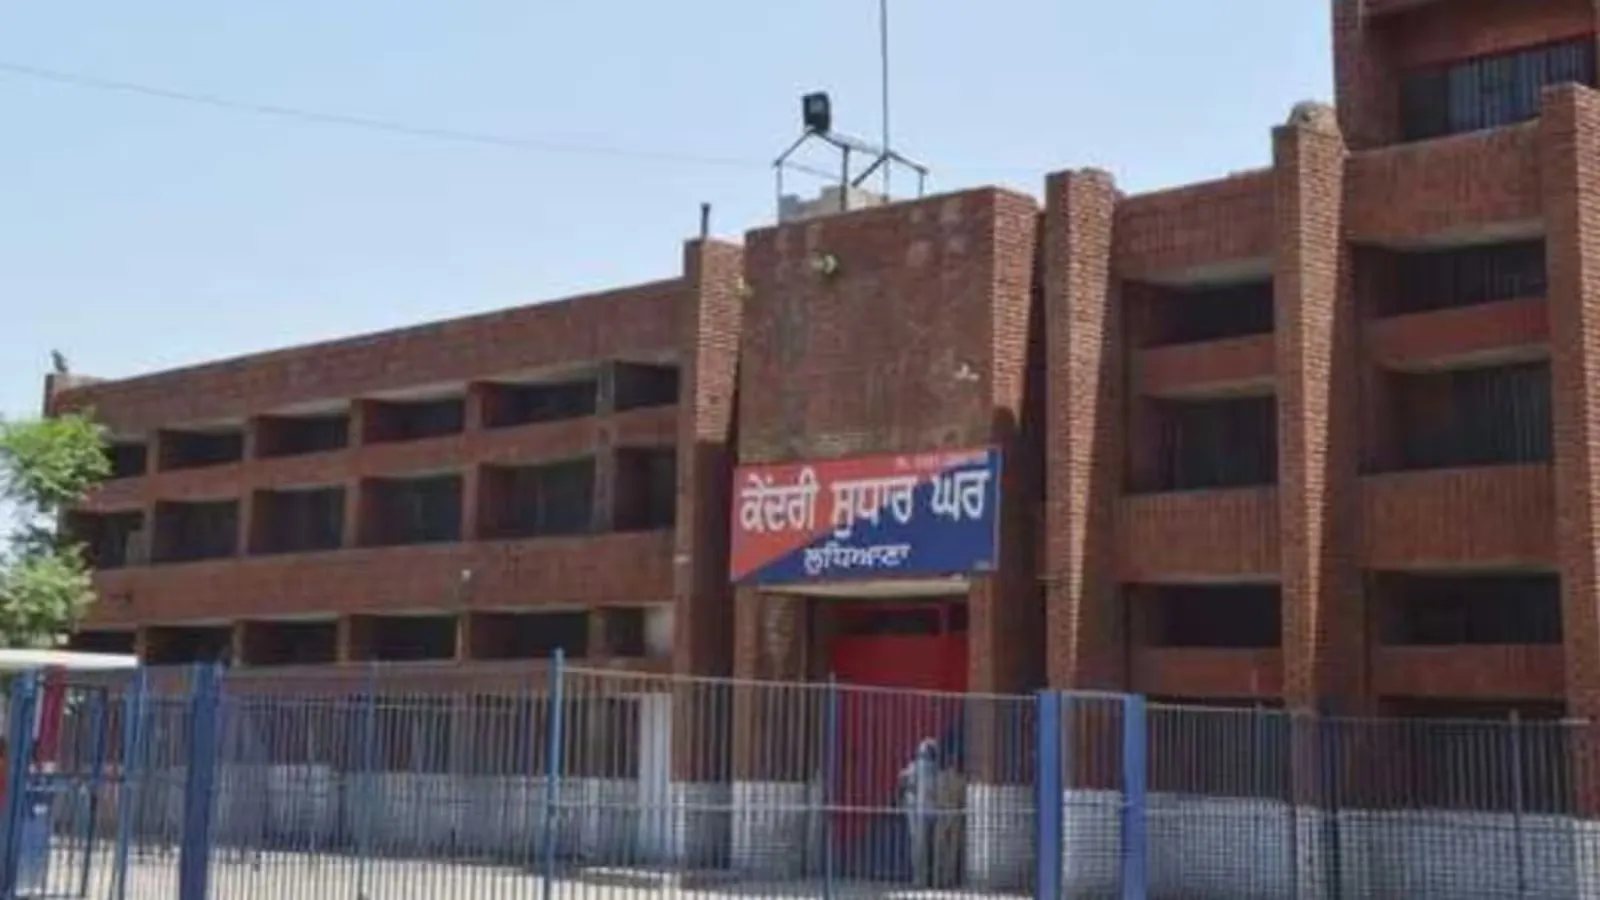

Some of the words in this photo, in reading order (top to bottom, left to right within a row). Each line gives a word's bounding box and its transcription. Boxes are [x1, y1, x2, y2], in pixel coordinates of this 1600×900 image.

[740, 466, 820, 532] ਕੇਂਦਰੀ
[830, 473, 917, 538] ਸੁਧਾਰ
[930, 469, 991, 521] ਘਰ
[803, 541, 912, 576] ਲੁਧਿਆਣਾ
